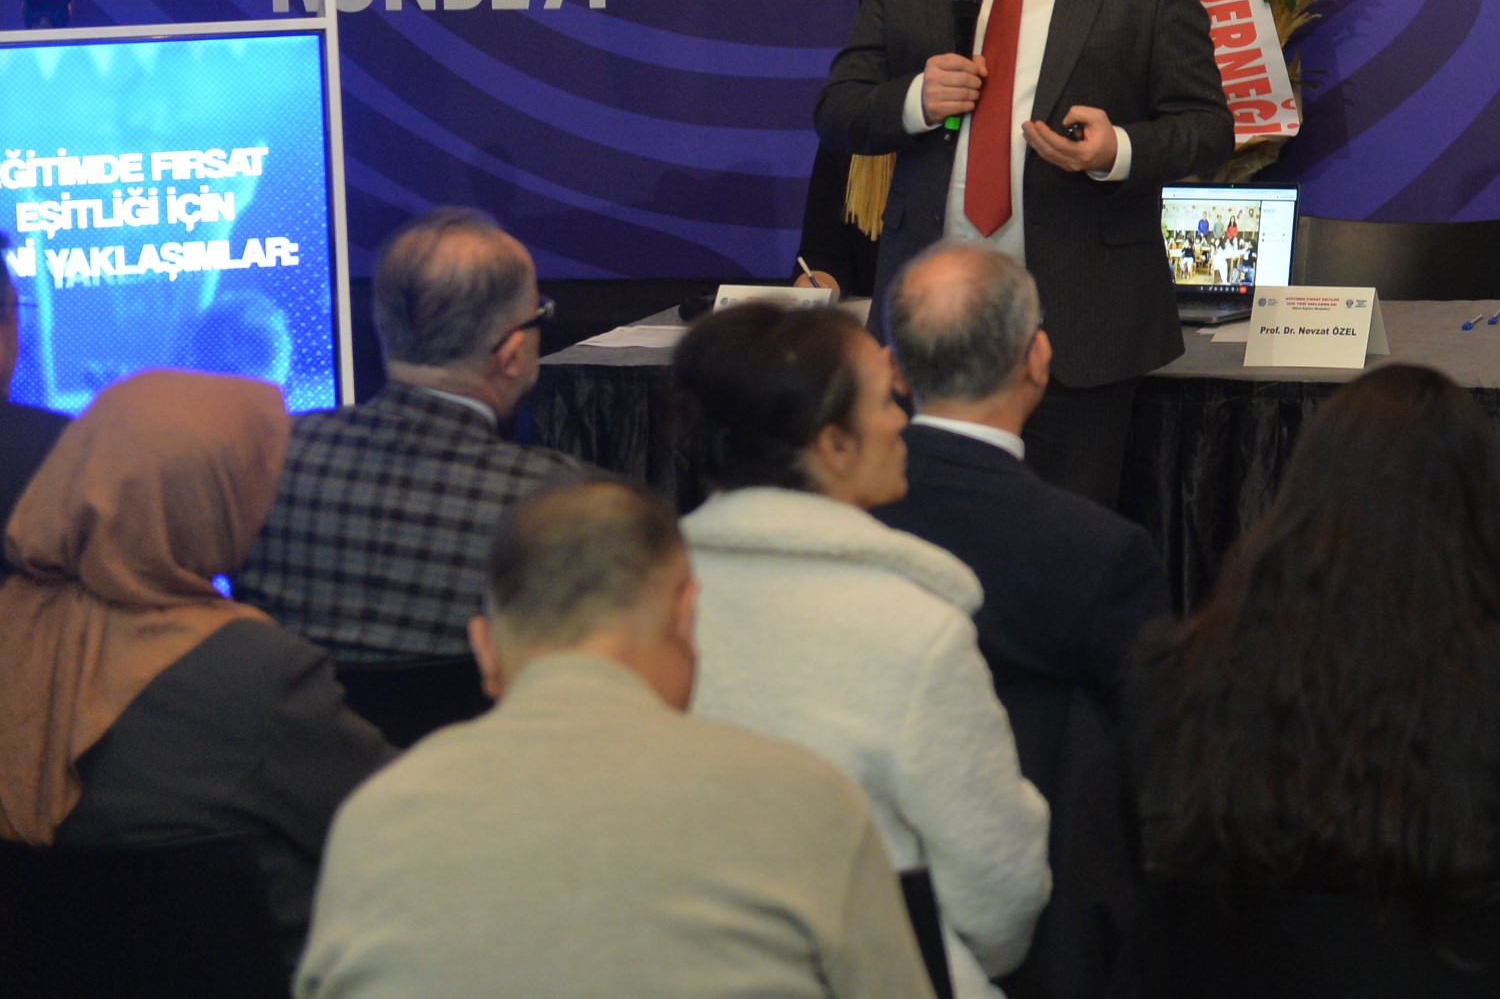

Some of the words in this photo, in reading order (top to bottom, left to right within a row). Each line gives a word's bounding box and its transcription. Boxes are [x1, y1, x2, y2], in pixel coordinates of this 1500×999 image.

[0, 148, 144, 189] ĞİTİMDE
[151, 146, 269, 181] FIRSAT
[16, 186, 159, 239] EŞİTLİĞİ
[166, 185, 236, 232] İÇİN
[45, 236, 299, 282] YAKLAŞIMLAR:
[1260, 326, 1280, 335] Prof.
[1283, 326, 1295, 335] Dr.
[1298, 326, 1329, 336] Nevzat
[1332, 326, 1357, 336] ÖZEL
